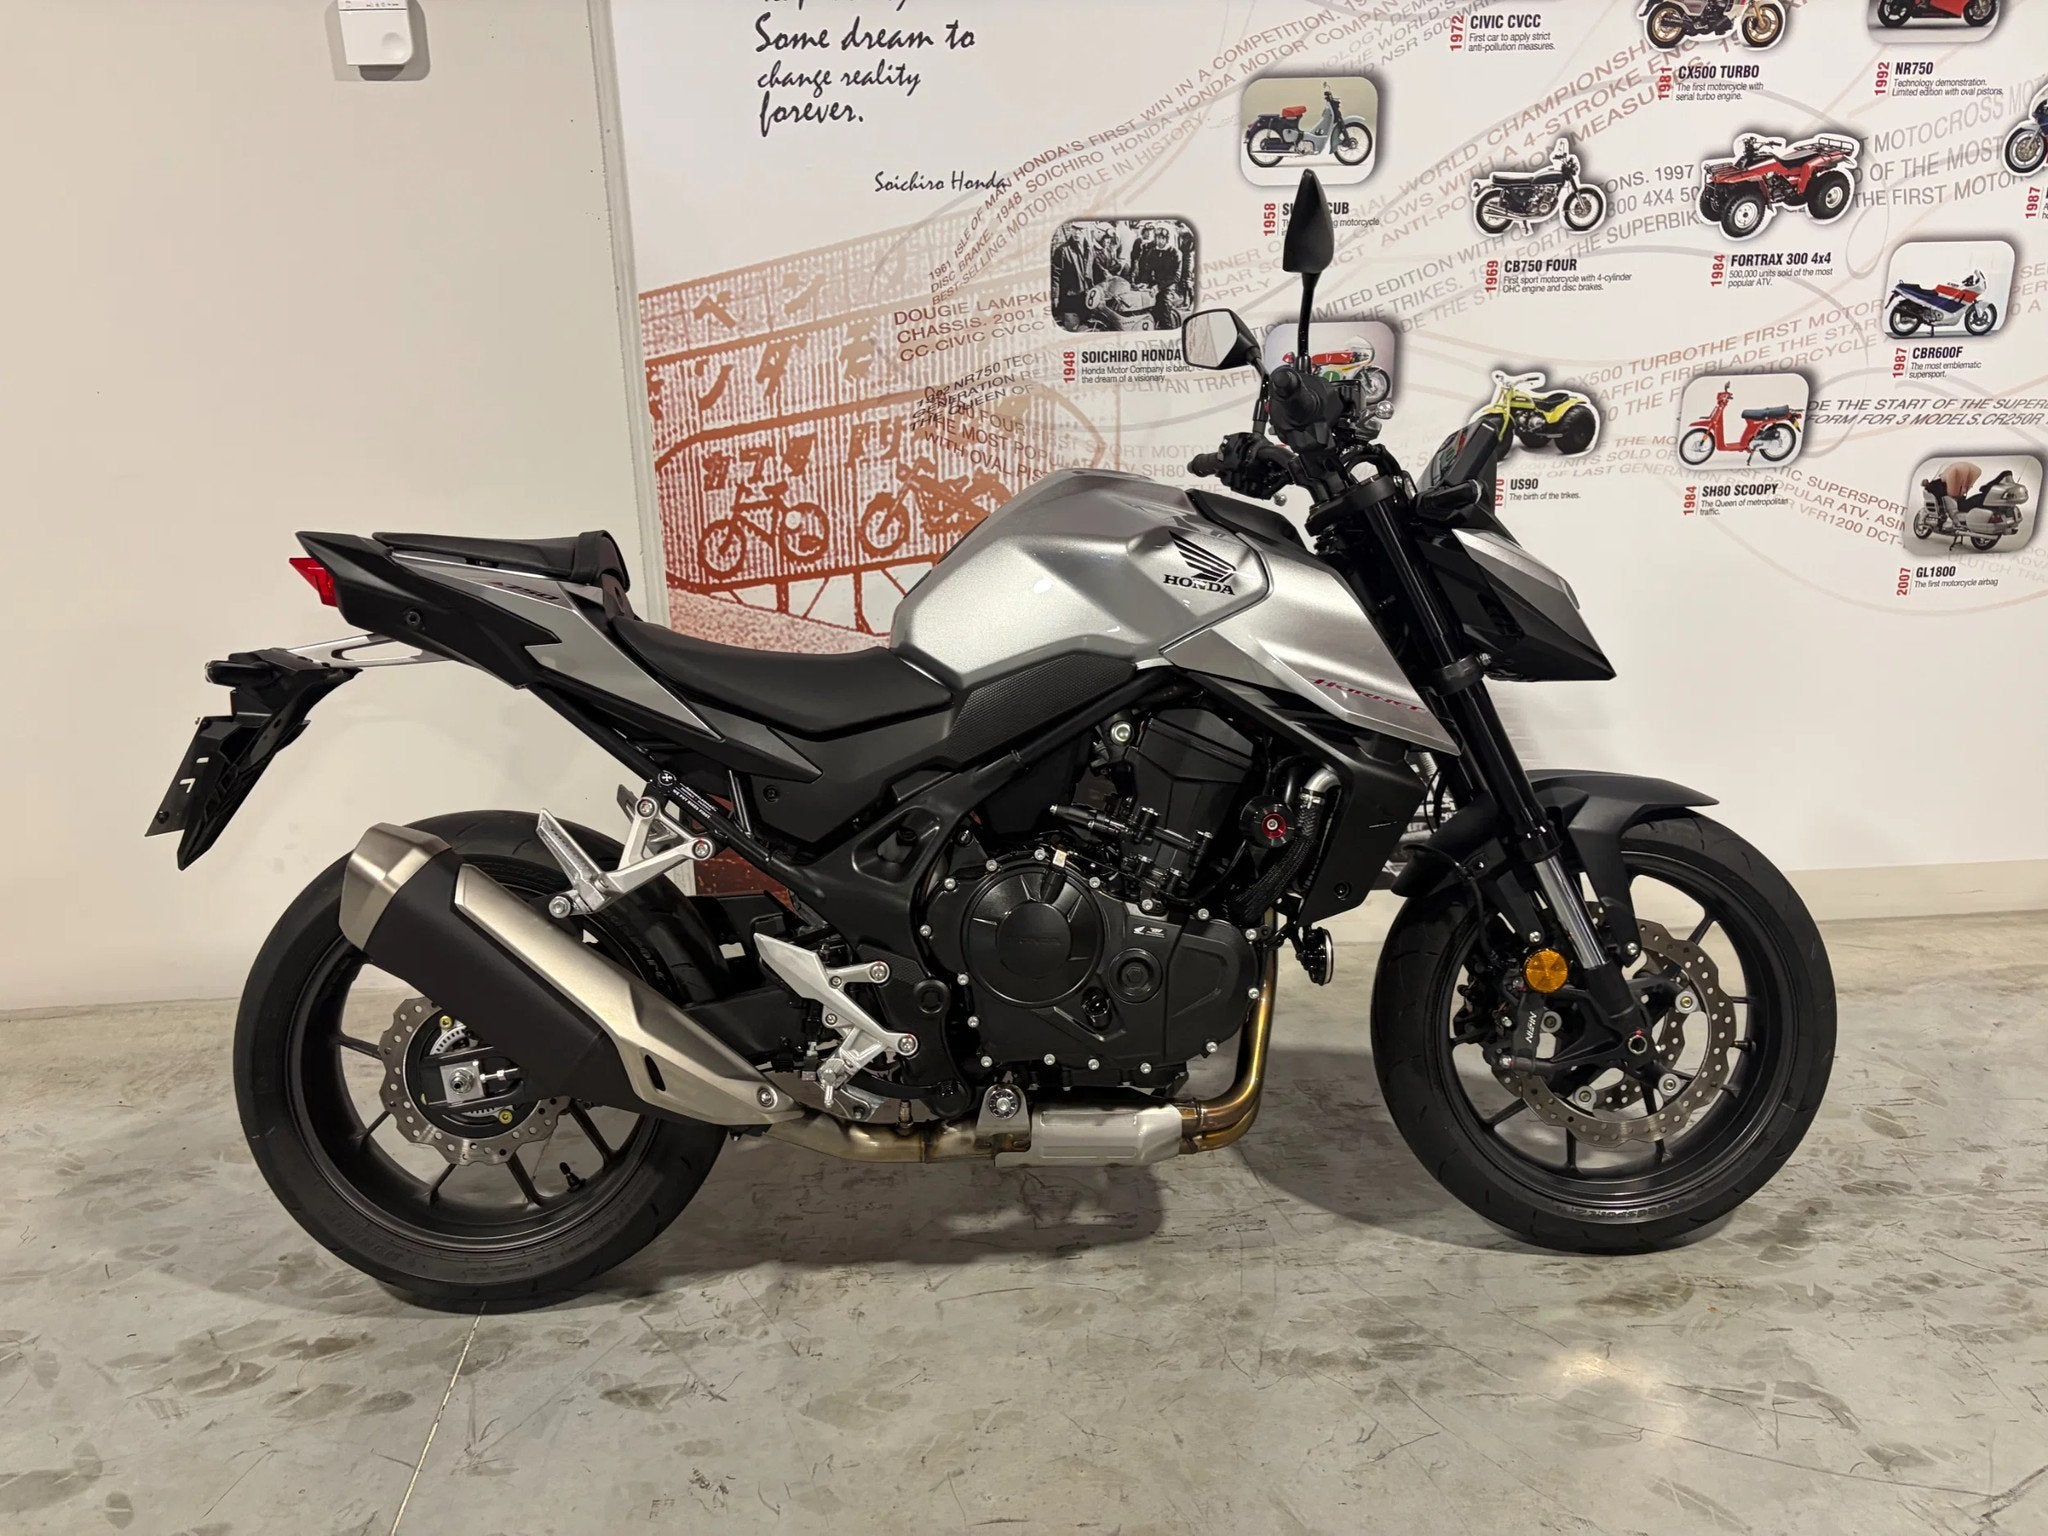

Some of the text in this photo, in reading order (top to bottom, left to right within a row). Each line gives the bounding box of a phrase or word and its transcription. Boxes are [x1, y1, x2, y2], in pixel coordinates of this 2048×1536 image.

[755, 12, 975, 52] Some dream to
[1470, 14, 1541, 29] CIVIC CVCC
[1450, 15, 1464, 51] 1972
[1469, 32, 1551, 43] First car to apply strict
[1381, 38, 1419, 65] NSR
[1469, 42, 1555, 53] anti-pollution measures.
[757, 59, 921, 98] change reality
[1678, 65, 1759, 78] CX500 TURBO
[1875, 62, 1889, 95] 1992
[1895, 62, 1933, 74] NR750
[1658, 67, 1672, 100] 1981
[1677, 82, 1764, 92] The first motorcycle with
[1892, 88, 1917, 96] Limited
[1919, 87, 1943, 95] edition
[1894, 78, 1987, 87] Technology demonstration.
[1676, 93, 1694, 101] serial
[1717, 93, 1742, 102] engine.
[760, 91, 863, 137] forever.
[971, 208, 986, 230] OF
[1013, 140, 1084, 181] HONDA'S
[1088, 119, 1136, 146] FIRST
[1140, 95, 1174, 122] WIN
[1175, 78, 1194, 97] IN
[1198, 69, 1211, 82] A
[1213, 9, 1340, 70] COMPETITION.
[1874, 95, 2004, 153] MOTOCROSS
[996, 191, 1023, 224] 1948
[1026, 151, 1104, 193] SOICHIRO
[1111, 117, 1172, 156] HONDA
[1175, 73, 1237, 116] HONDA
[1239, 39, 1309, 75] MOTOR
[1438, 67, 1644, 197] WITH A 4-STROKE
[1869, 136, 2004, 181] OF THE MOST
[875, 170, 1006, 192] Soichiro Honda
[1399, 144, 1479, 196] WORLD
[1655, 164, 1694, 181] 1997
[1006, 167, 1113, 238] MOTORCYCLE
[1643, 188, 1674, 206] 4X4
[1854, 185, 1948, 208] THE FIRST
[2025, 187, 2040, 218] 1987
[1263, 203, 1276, 236] 1958
[1339, 218, 1380, 228] motorcycle
[1376, 256, 1453, 295] EDITION
[1457, 236, 1505, 265] WITH
[1505, 259, 1577, 273] CB750 FOUR
[1731, 252, 1831, 267] FORTRAX 300 4x4
[1485, 260, 1499, 293] 1969
[1504, 273, 1632, 285] First sport motorcycle with 4-cylinder
[1711, 255, 1725, 287] 1984
[1729, 268, 1833, 278] 500,000 units sold of the most
[1522, 285, 1545, 294] engine
[1547, 284, 1560, 292] and
[1728, 277, 1773, 288] popular ATV.
[1393, 278, 1463, 314] TRIKES.
[894, 302, 970, 325] DOUGIE
[1428, 296, 1473, 321] THE
[897, 308, 1035, 343] CHASSIS. 2001
[991, 321, 1046, 338] CVCC
[1743, 319, 1802, 346] FIRST
[1082, 349, 1181, 363] SOICHIRO HONDA
[1660, 333, 1817, 384] FIREBLADE THE
[1893, 348, 1907, 378] 1987
[1913, 347, 1963, 359] CBR600F
[954, 362, 1001, 390] NR750
[1063, 352, 1075, 383] 1948
[1130, 365, 1163, 374] Company
[1909, 371, 1947, 379] supersport.
[1943, 361, 1982, 369] emblematic
[1095, 375, 1117, 383] dream
[1626, 392, 1663, 415] THE
[1839, 399, 1993, 410] THE START OF THE
[1857, 413, 1909, 425] FOR 3
[962, 424, 1009, 450] MOST
[1615, 436, 1647, 447] THE
[925, 431, 965, 457] WITH
[971, 450, 1012, 475] OVAL
[1606, 449, 1650, 461] SOLD
[1573, 465, 1617, 477] LAST
[1511, 479, 1538, 489] US90
[1702, 484, 1779, 497] SH80 SCOOPY
[1683, 485, 1697, 516] 1984
[1806, 476, 1908, 516] SUPERSPORT
[1700, 508, 1720, 516] traffic.
[1799, 503, 1863, 533] VFR1200
[1837, 502, 1870, 520] ATV.
[1897, 568, 1911, 596] 2007
[1916, 566, 1956, 578] GL1800
[1163, 574, 1236, 596] HONDA
[1928, 580, 1940, 588] first
[1941, 580, 1977, 588] motorcycle
[1978, 579, 1998, 587] airbag
